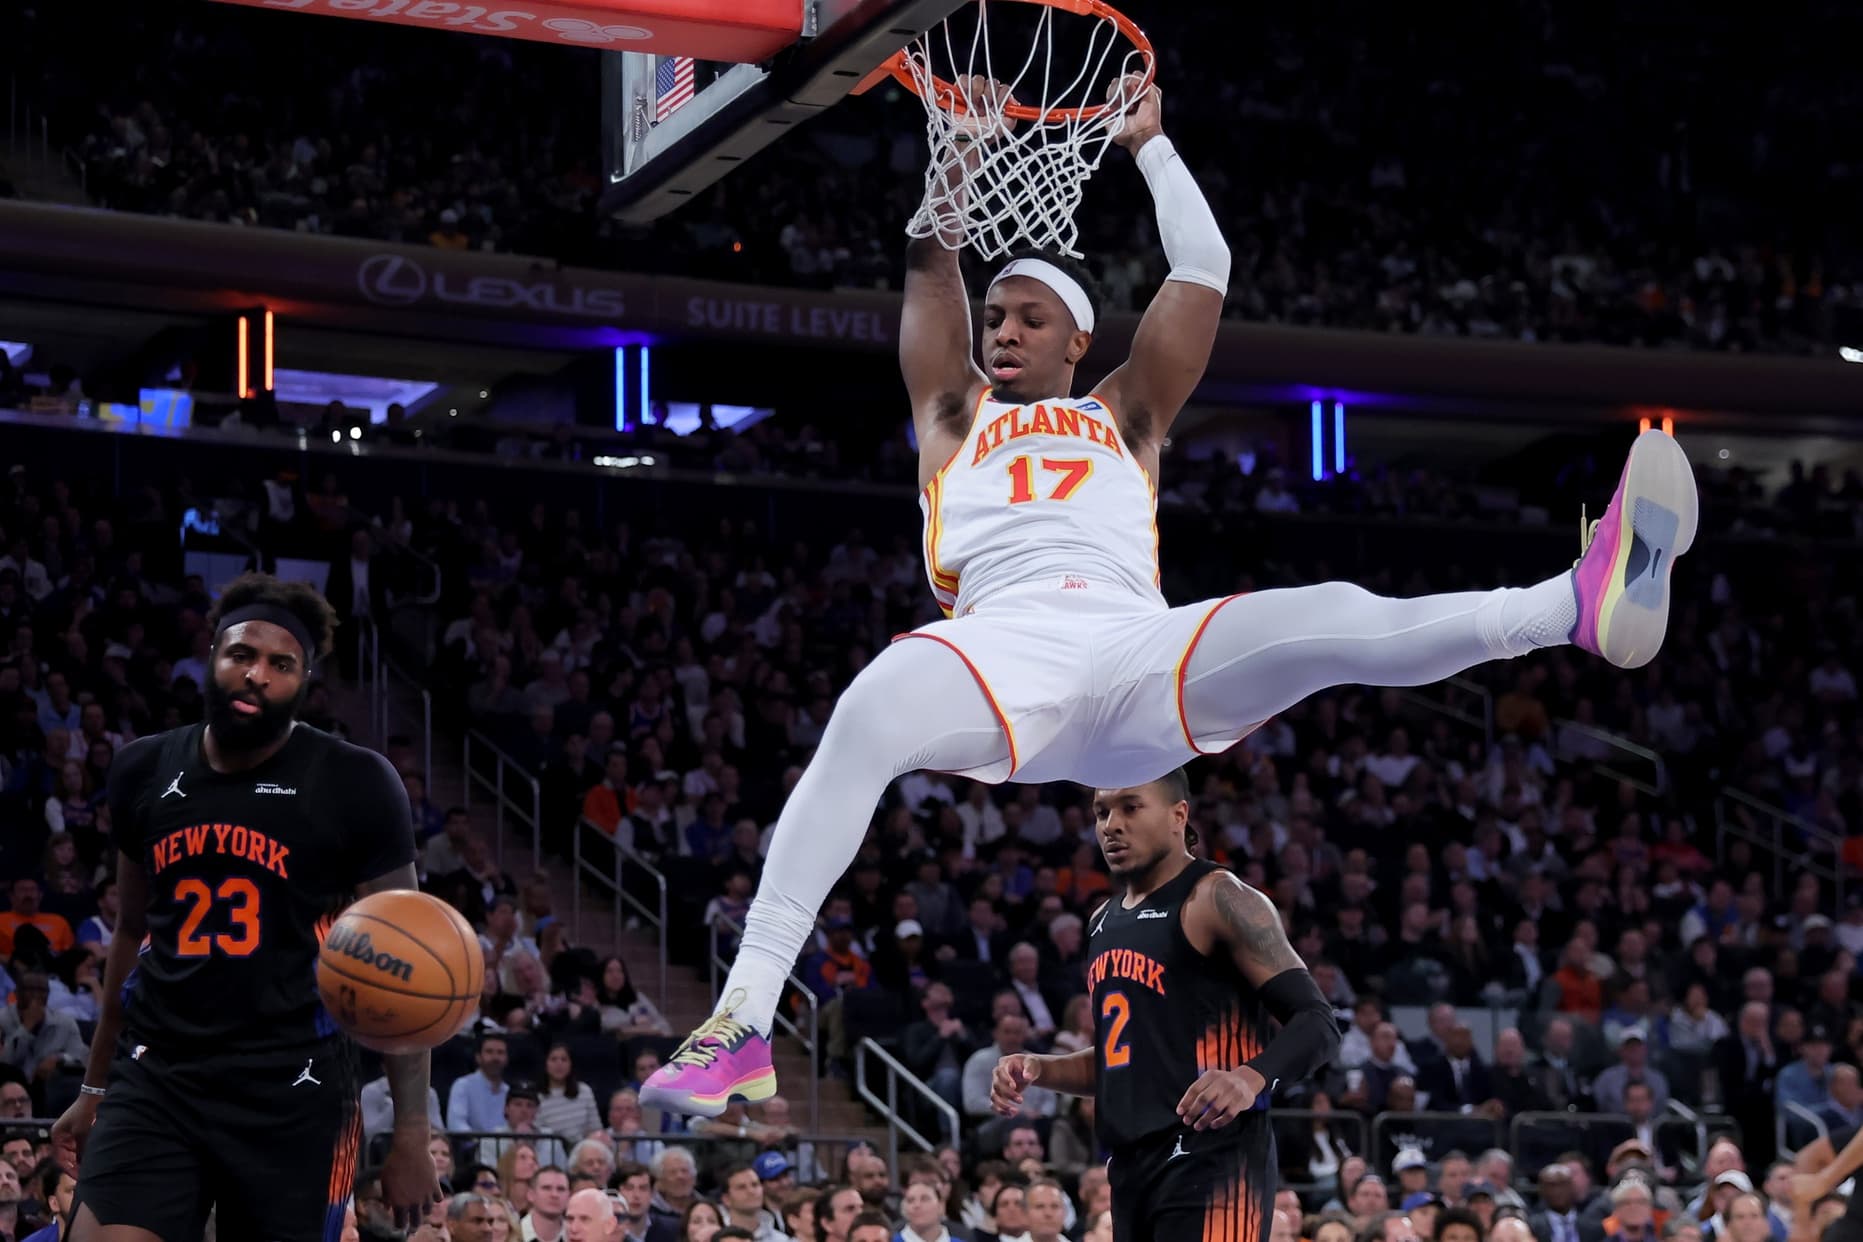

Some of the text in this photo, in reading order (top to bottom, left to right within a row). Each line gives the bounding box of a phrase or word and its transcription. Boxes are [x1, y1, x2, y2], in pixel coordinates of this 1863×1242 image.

[433, 272, 625, 317] LEXUS
[687, 297, 888, 341] SUITE LEVEL
[971, 404, 1124, 467] ATLANTA
[1006, 455, 1094, 504] 17
[153, 824, 290, 879] NEW YORK
[174, 877, 261, 957] 23
[325, 925, 413, 982] Wilson
[1111, 949, 1165, 996] YORK
[1102, 991, 1131, 1070] 2
